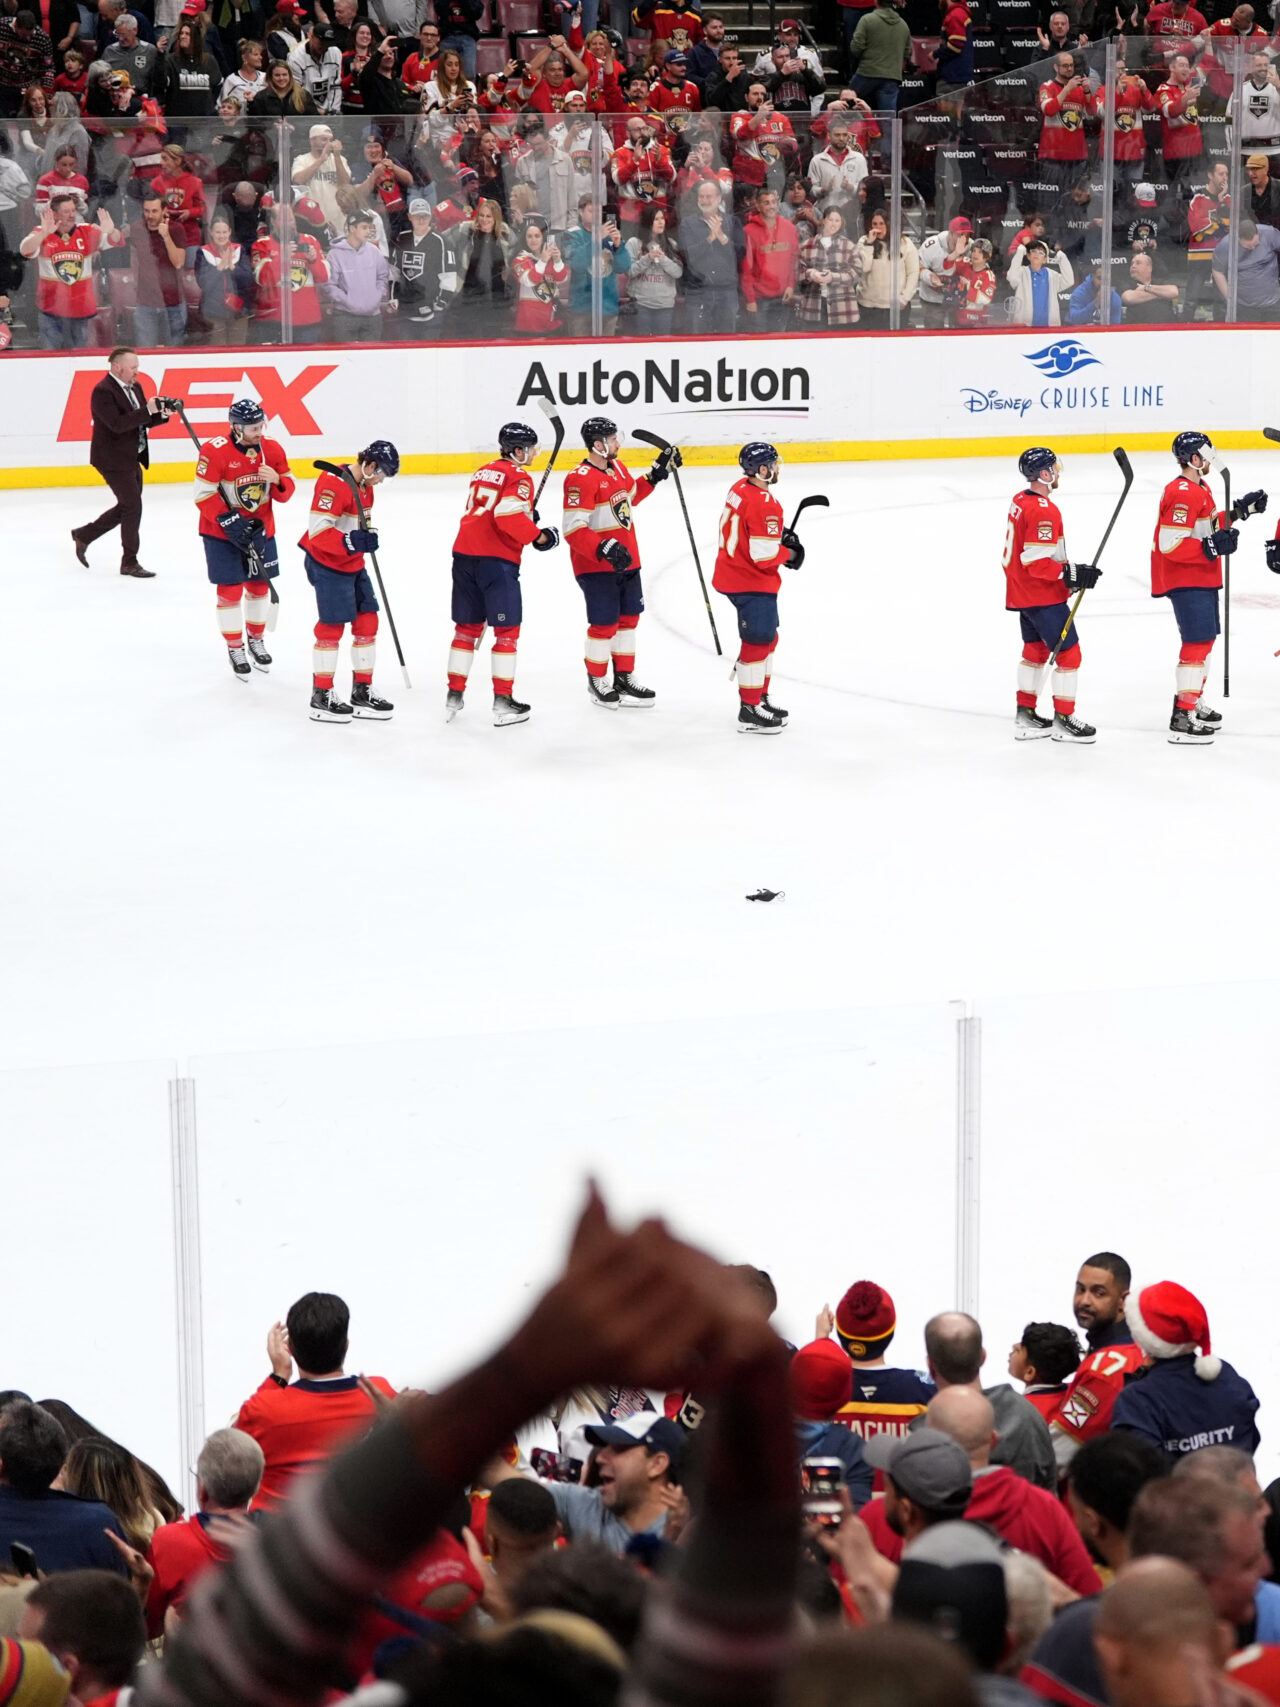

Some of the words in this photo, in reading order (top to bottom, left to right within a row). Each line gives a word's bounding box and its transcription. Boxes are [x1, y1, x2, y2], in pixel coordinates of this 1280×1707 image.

[1162, 17, 1194, 37] PANTHERS
[972, 39, 995, 47] rizon
[179, 73, 210, 87] KINGS
[900, 79, 924, 88] rizon
[995, 77, 1027, 86] verizon
[686, 93, 692, 104] C
[1251, 96, 1269, 106] LA
[915, 114, 950, 123] verizon
[970, 113, 1005, 122] verizon
[943, 150, 975, 159] verizon
[994, 149, 1027, 159] verizon
[969, 185, 1002, 194] verizon
[1022, 182, 1059, 192] verizon
[76, 238, 85, 249] C
[403, 253, 423, 265] LA
[1091, 256, 1128, 265] vezon
[974, 280, 982, 290] C
[517, 357, 810, 406] AutoNation
[1041, 386, 1110, 409] CRUISE
[1123, 385, 1164, 407] LINE
[1179, 481, 1189, 490] 2
[1038, 498, 1048, 507] 9
[220, 513, 240, 527] CCM
[1090, 1350, 1128, 1377] 17
